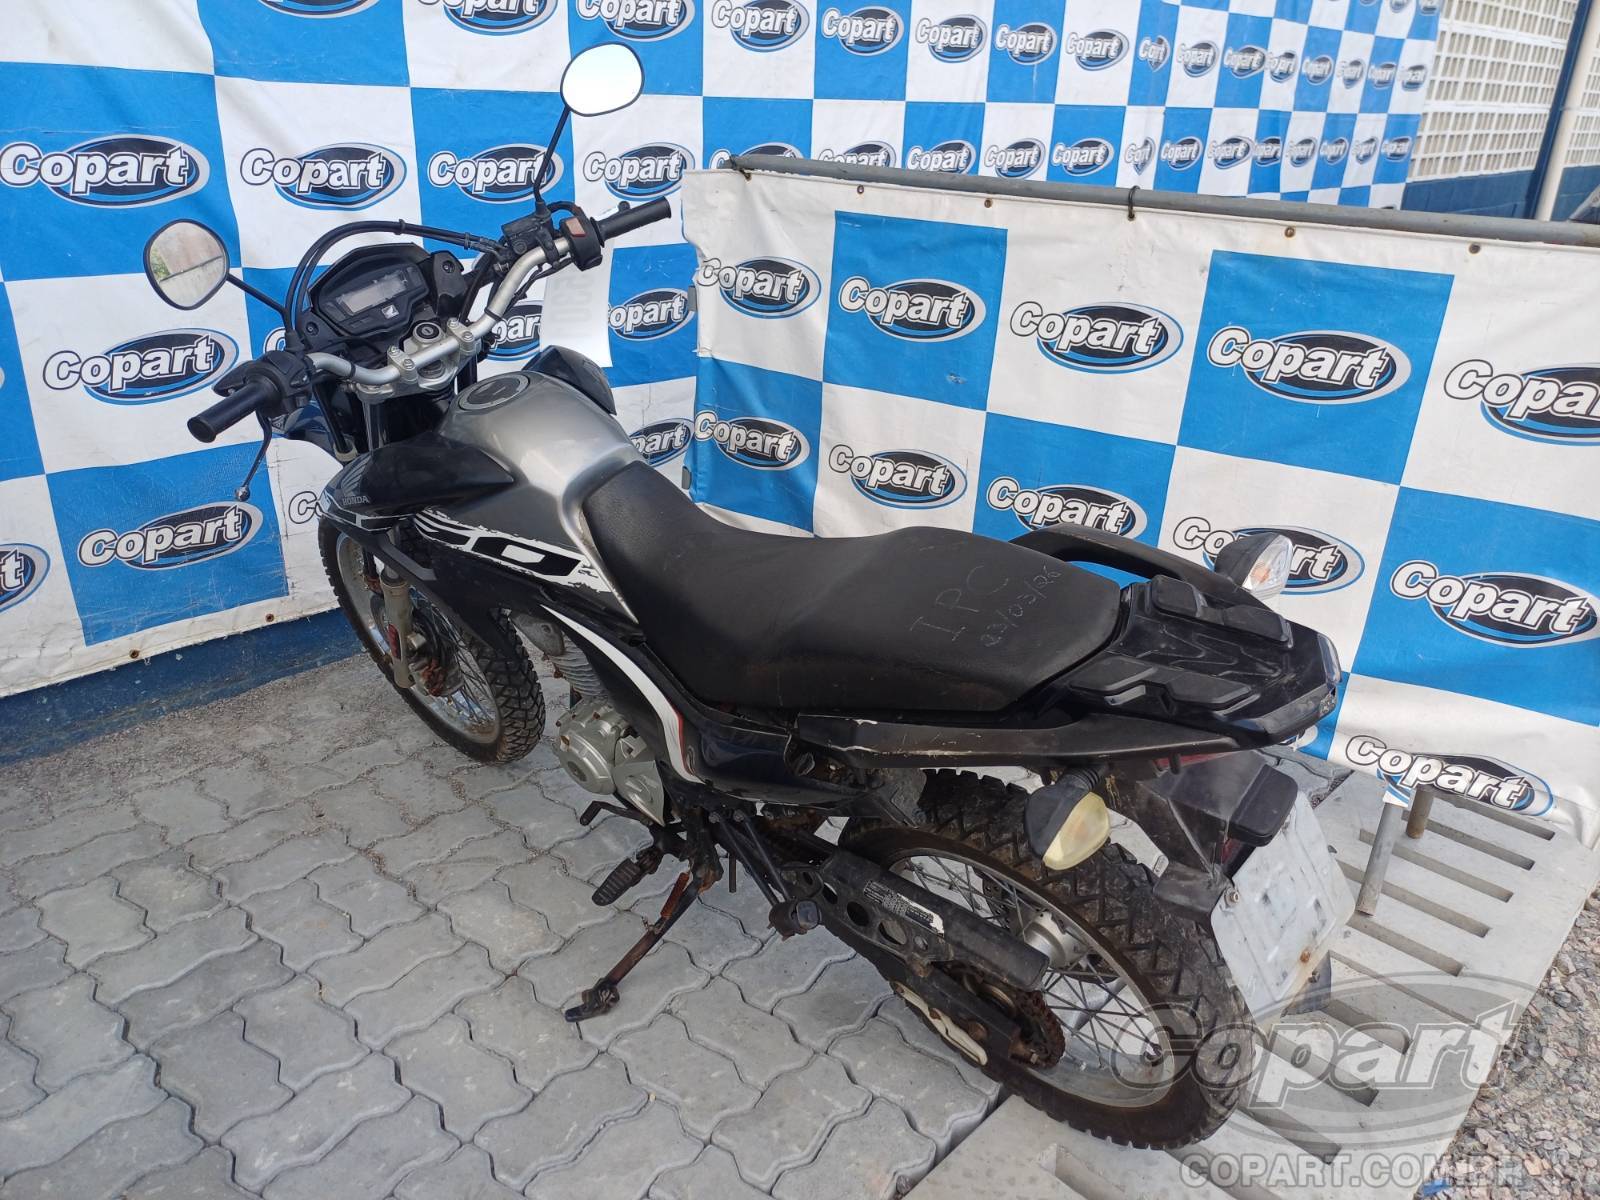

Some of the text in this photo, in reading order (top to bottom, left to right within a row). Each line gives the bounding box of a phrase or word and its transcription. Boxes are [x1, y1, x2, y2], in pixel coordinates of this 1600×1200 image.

[711, 0, 797, 39] Copart
[822, 8, 898, 45] Copart
[915, 17, 980, 53] Copart
[995, 24, 1051, 57] Copart
[1066, 32, 1121, 62] Copart
[0, 142, 190, 195] Copart
[240, 147, 385, 194] Copart
[583, 150, 682, 188] Copart
[984, 144, 1039, 171] Copart
[1052, 142, 1105, 171] Copart
[1161, 139, 1200, 166] Copart
[696, 257, 804, 303] Copart
[839, 276, 968, 328] Copart
[608, 293, 685, 333] opart
[1009, 301, 1163, 355] Copart
[43, 335, 215, 392] Copart
[1206, 326, 1389, 389] Copart
[1443, 359, 1600, 422] Copa
[631, 423, 687, 454] part
[694, 410, 796, 462] Copart
[828, 444, 952, 496] Copart
[987, 476, 1130, 535] Copart
[78, 504, 243, 568] Copart
[1173, 516, 1340, 581] Cort
[1390, 560, 1590, 635] Copart
[1345, 734, 1530, 810] Copart
